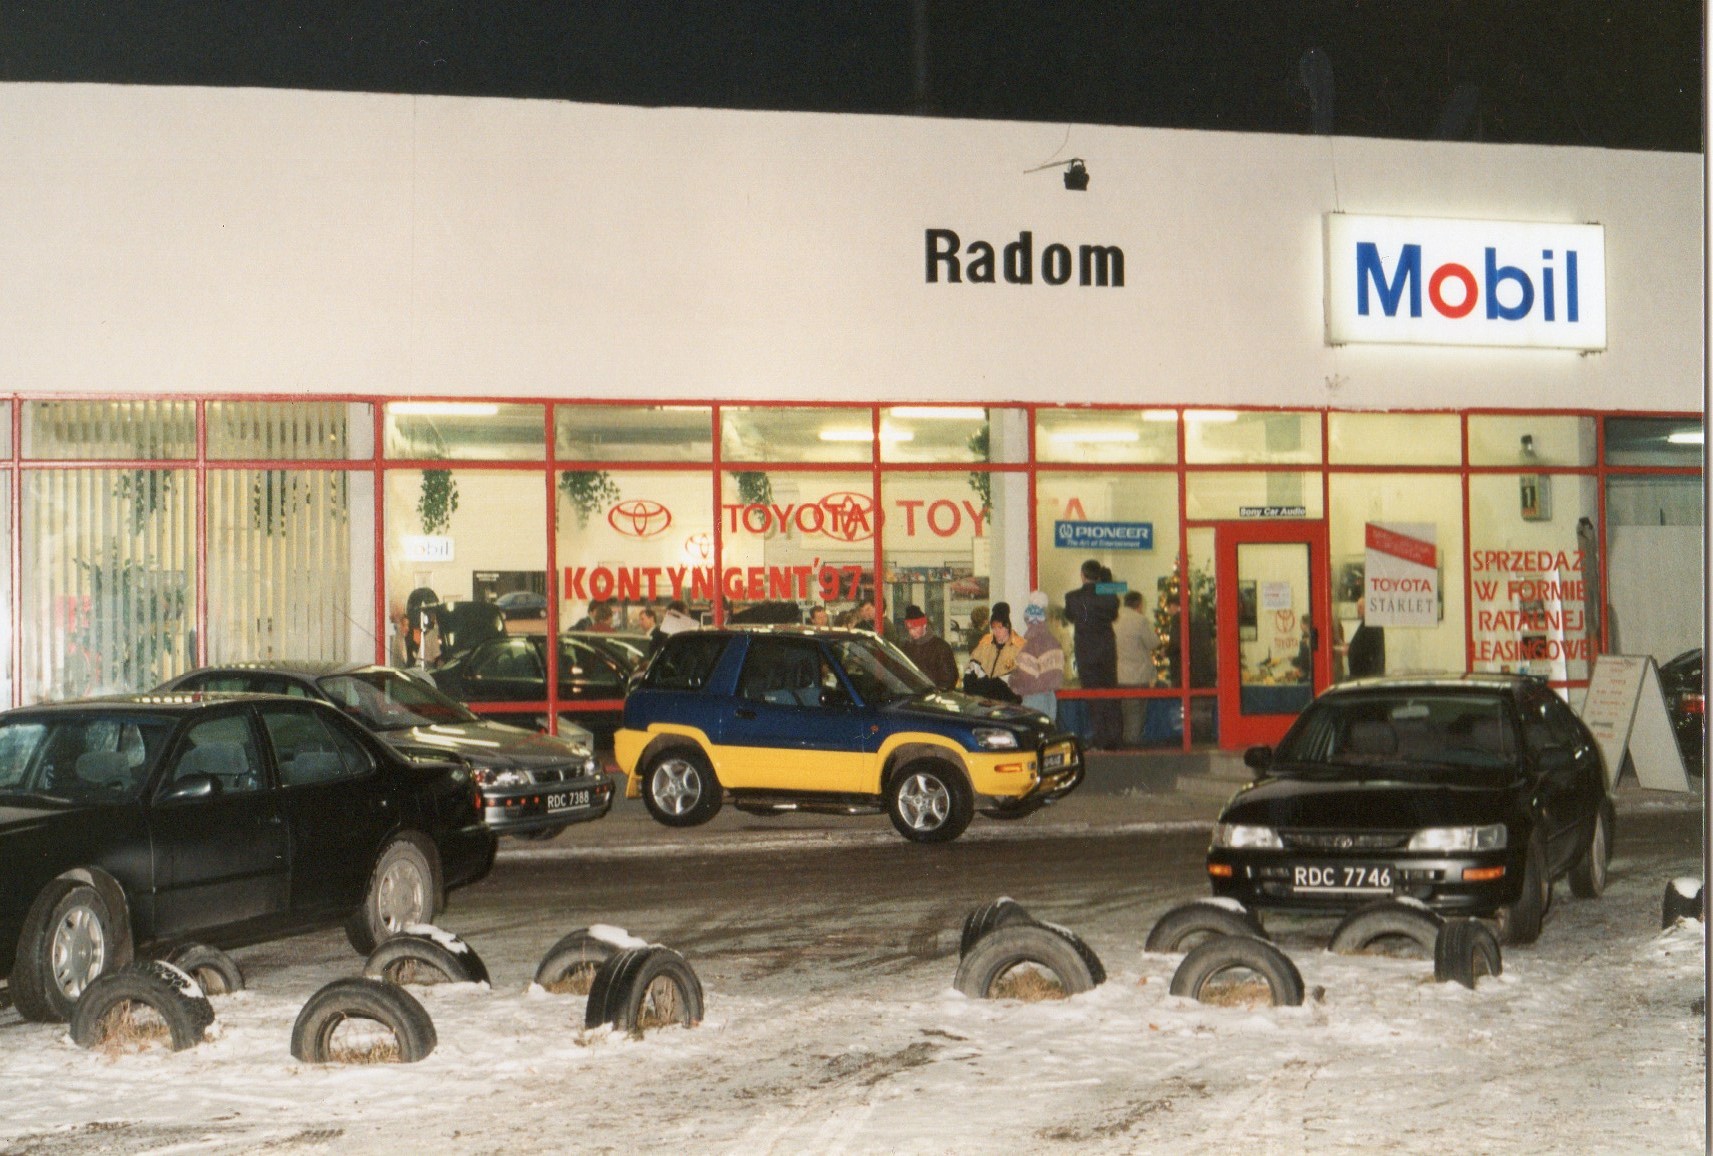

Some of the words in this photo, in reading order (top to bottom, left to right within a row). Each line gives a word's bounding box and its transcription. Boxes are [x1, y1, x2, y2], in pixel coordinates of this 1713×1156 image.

[924, 228, 1125, 288] Radom
[1356, 241, 1580, 323] Mobil
[722, 503, 870, 534] TOYOTA
[1240, 508, 1262, 517] Sony
[1264, 508, 1279, 516] Car
[1281, 507, 1306, 516] Audio
[1075, 526, 1149, 539] PIONEER
[1370, 578, 1433, 592] TOYOTA
[1474, 580, 1498, 601] W
[1507, 579, 1589, 602] FORMIE
[1369, 597, 1433, 613] STARLET
[1478, 610, 1584, 632] RATALNEJ
[547, 793, 567, 809] RDC
[569, 790, 590, 806] 7388
[1294, 866, 1335, 887] RDC
[1343, 867, 1391, 887] 7746
